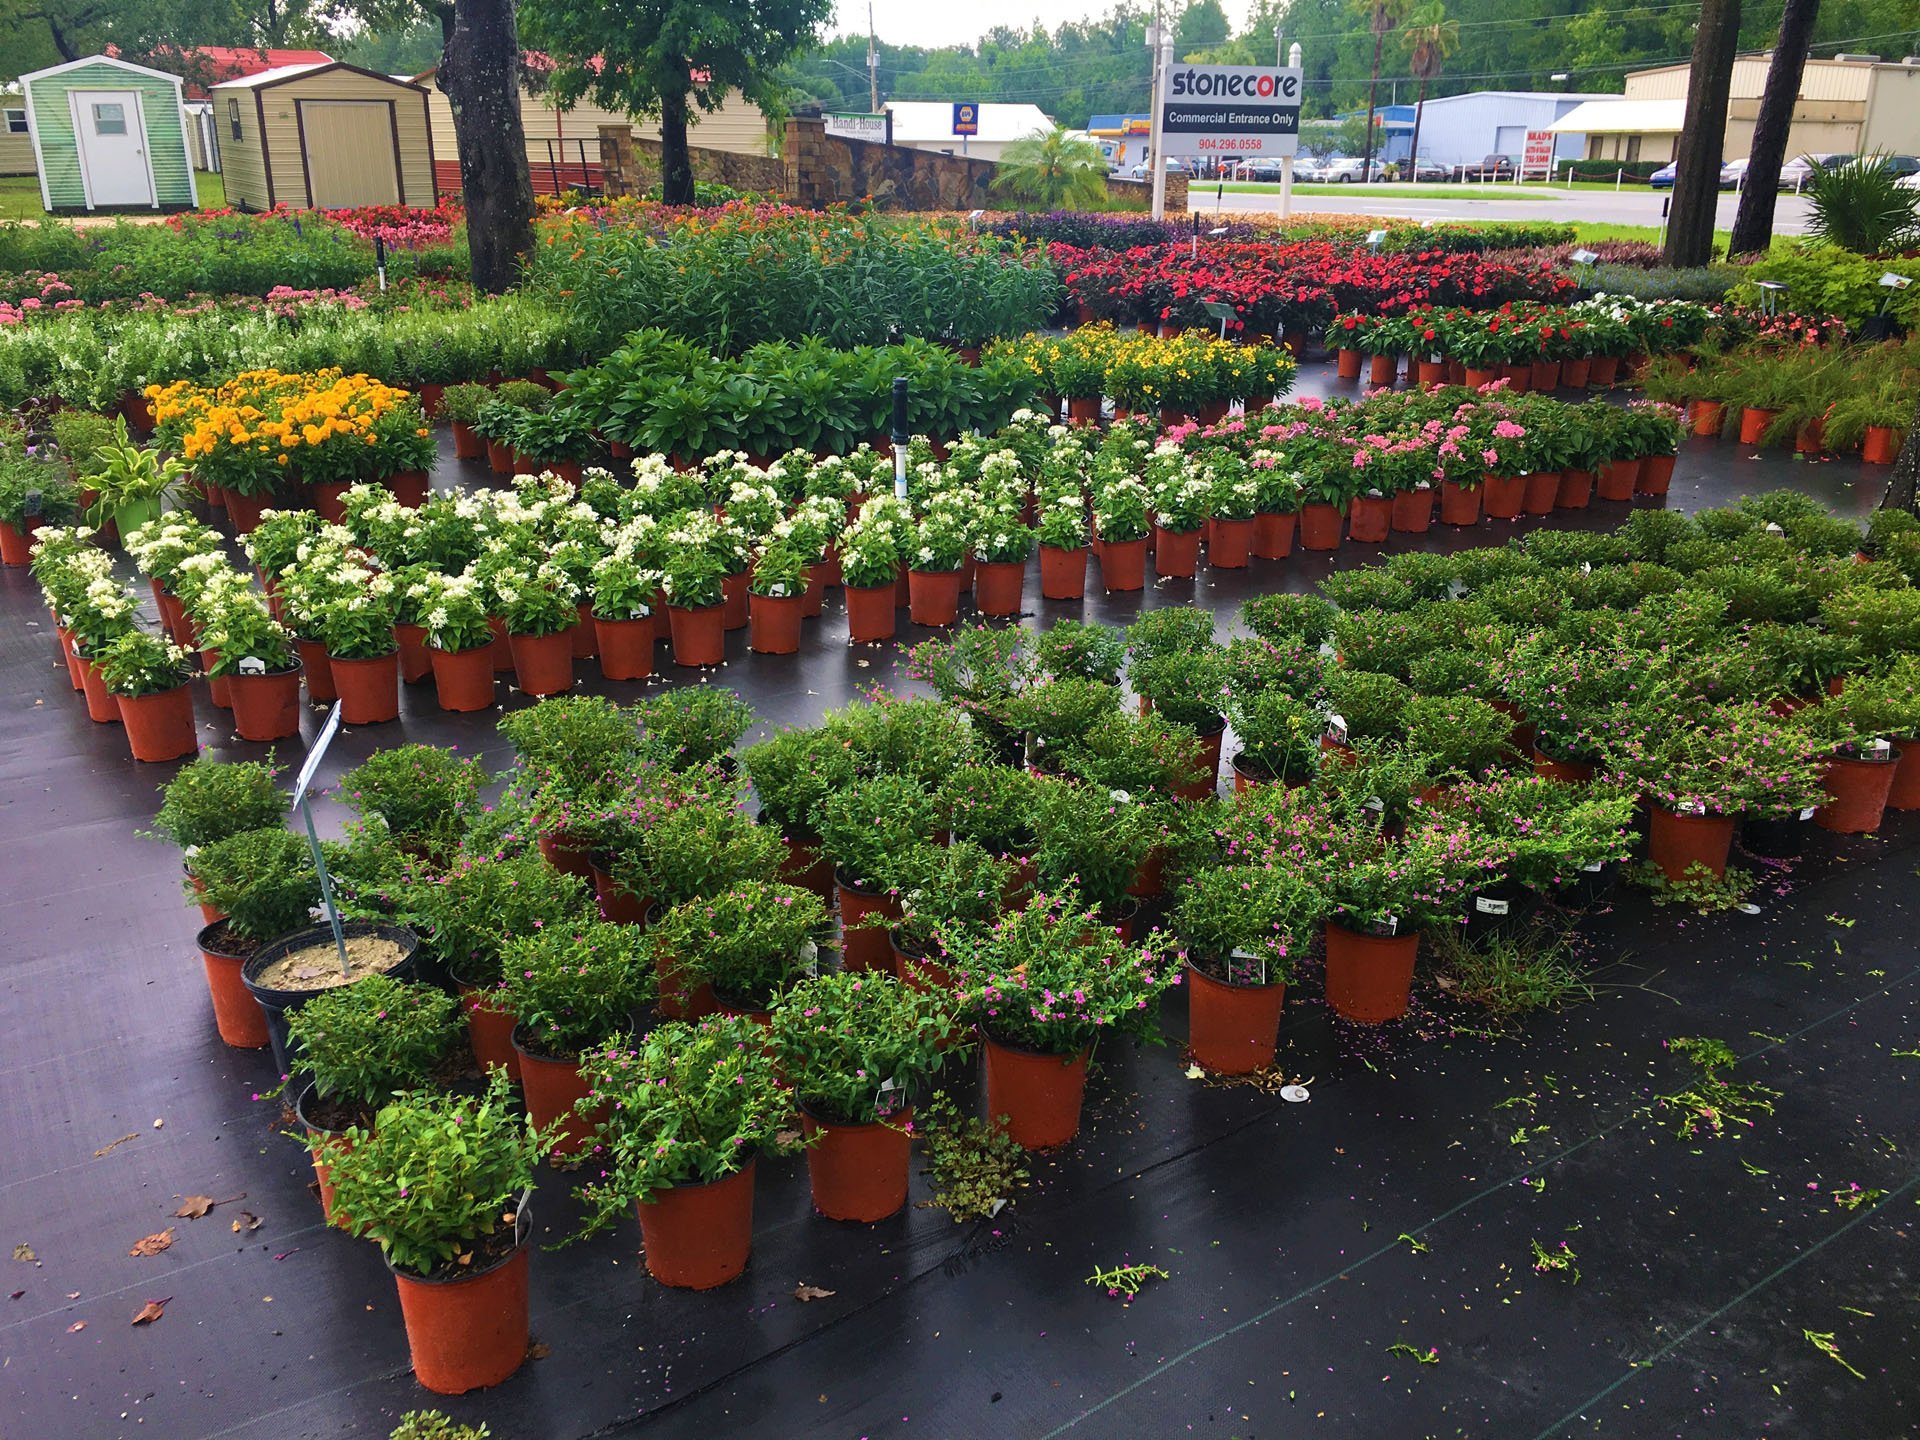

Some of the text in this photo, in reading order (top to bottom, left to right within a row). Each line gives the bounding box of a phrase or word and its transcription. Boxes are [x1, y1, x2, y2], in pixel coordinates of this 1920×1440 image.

[1172, 68, 1297, 97] stonecore
[1169, 111, 1294, 127] Commercial Entrance Only
[1527, 132, 1552, 140] BRAD'S
[1199, 138, 1262, 150] 904.296.0558
